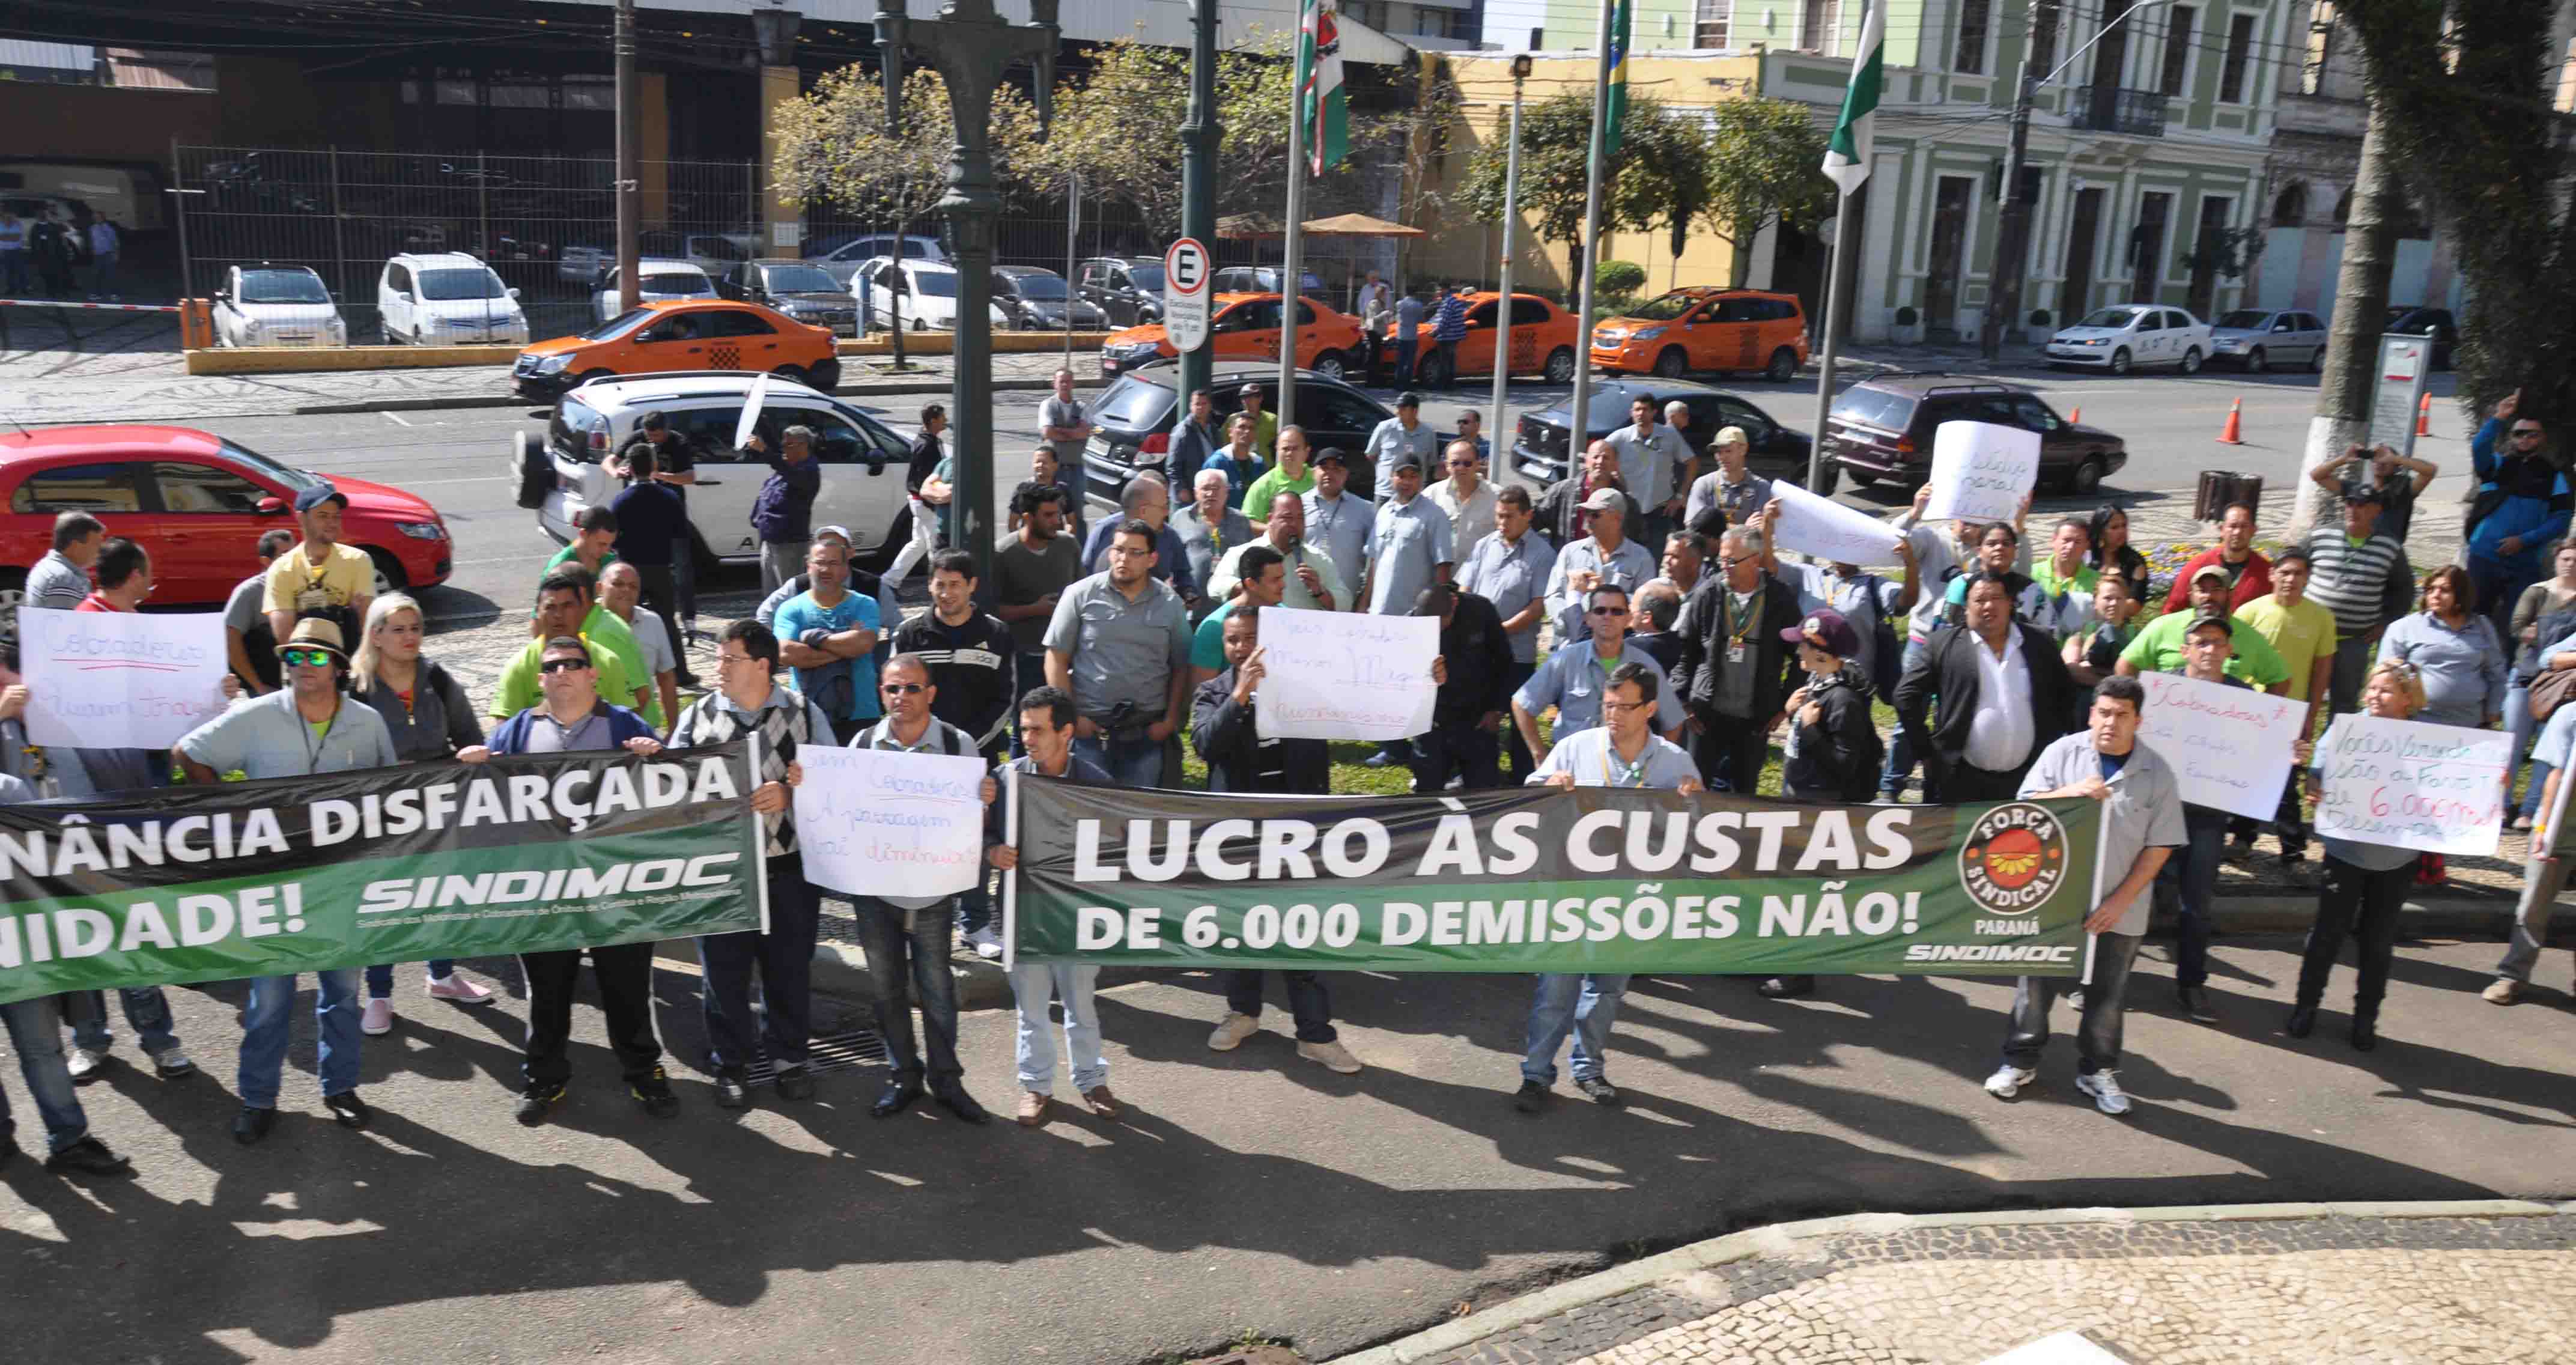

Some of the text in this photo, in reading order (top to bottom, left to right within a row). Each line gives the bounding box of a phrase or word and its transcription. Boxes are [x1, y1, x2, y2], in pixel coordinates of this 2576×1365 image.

[1178, 249, 1196, 284] E
[0, 757, 738, 880] NÂNCIA DISFARÇADA
[1979, 809, 2055, 840] FORÇA
[1074, 798, 1913, 881] LUCRO ÀS CUSTAS
[356, 852, 741, 914] SINDIMOC
[1967, 866, 2057, 906] SINDICAL
[551, 902, 585, 914] Ônibus
[645, 893, 680, 905] Região
[1076, 880, 1922, 950] DE 6.000 DEMISSÕES NÃO!
[1974, 917, 2040, 935] PARANÁ
[1903, 945, 2078, 962] SINDIMOC
